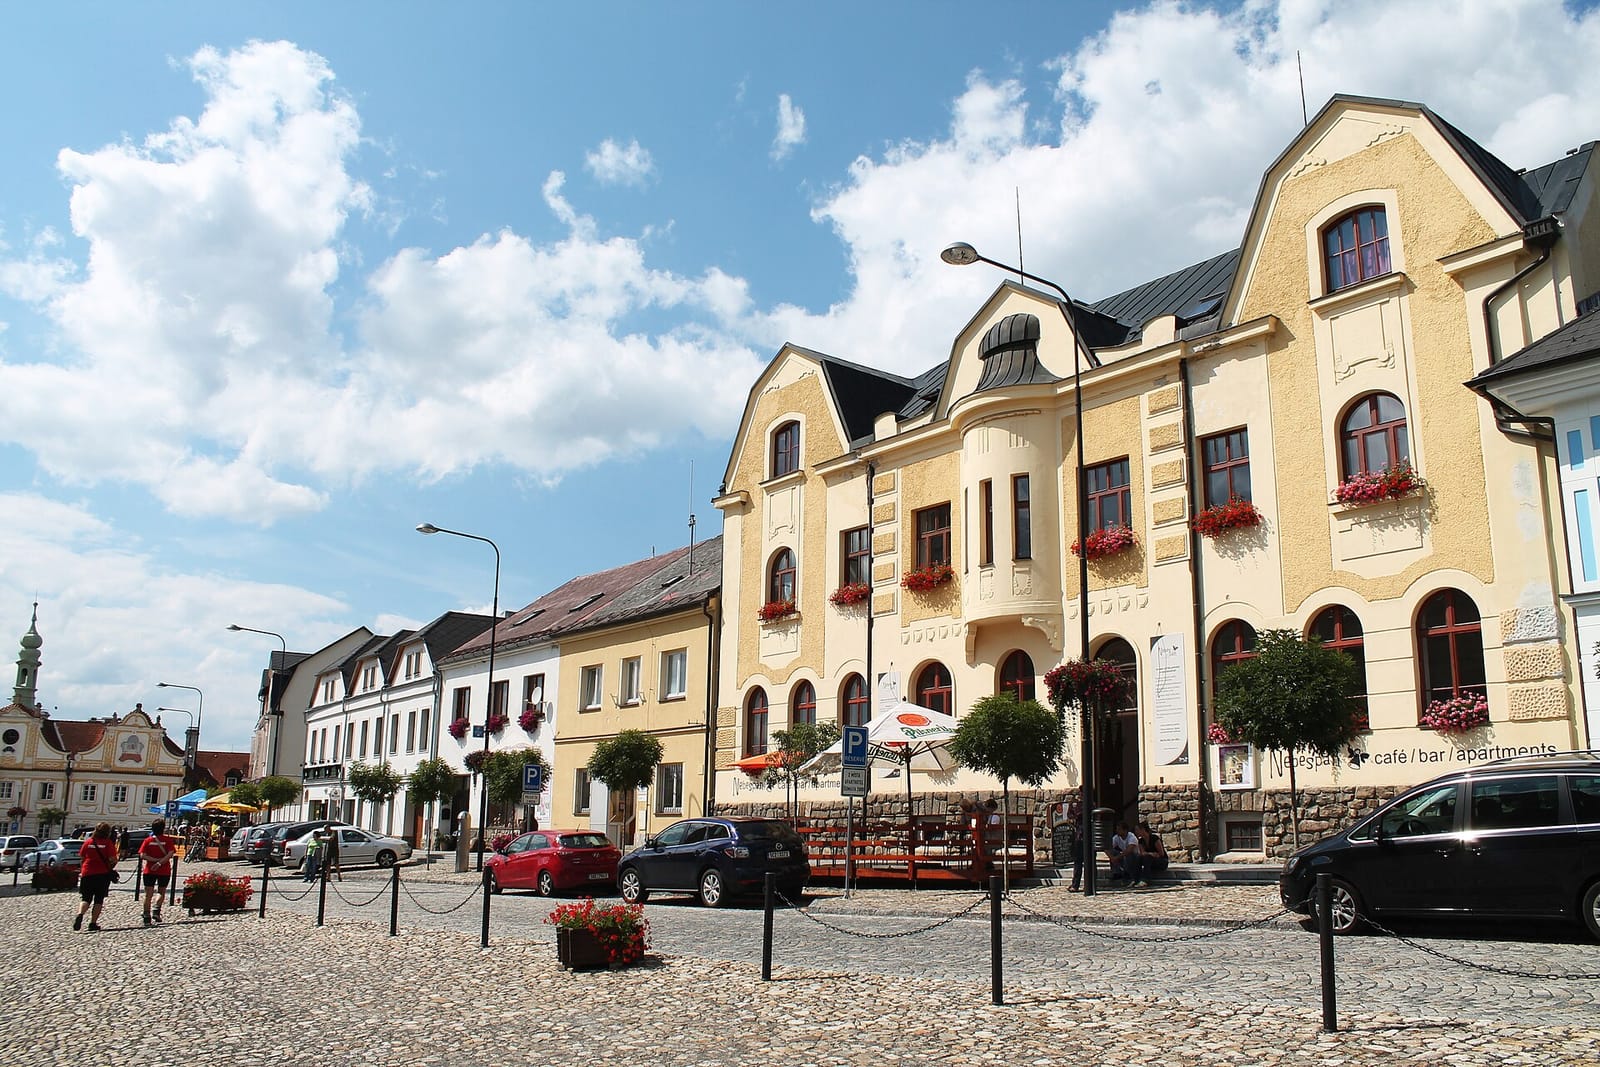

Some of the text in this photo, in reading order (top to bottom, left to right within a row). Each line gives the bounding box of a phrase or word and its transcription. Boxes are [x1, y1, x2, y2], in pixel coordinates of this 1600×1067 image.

[848, 731, 863, 754] P
[1374, 749, 1407, 765] café
[1419, 748, 1445, 763] bar
[1456, 743, 1557, 764] apartments
[527, 768, 538, 784] P
[168, 802, 176, 813] P
